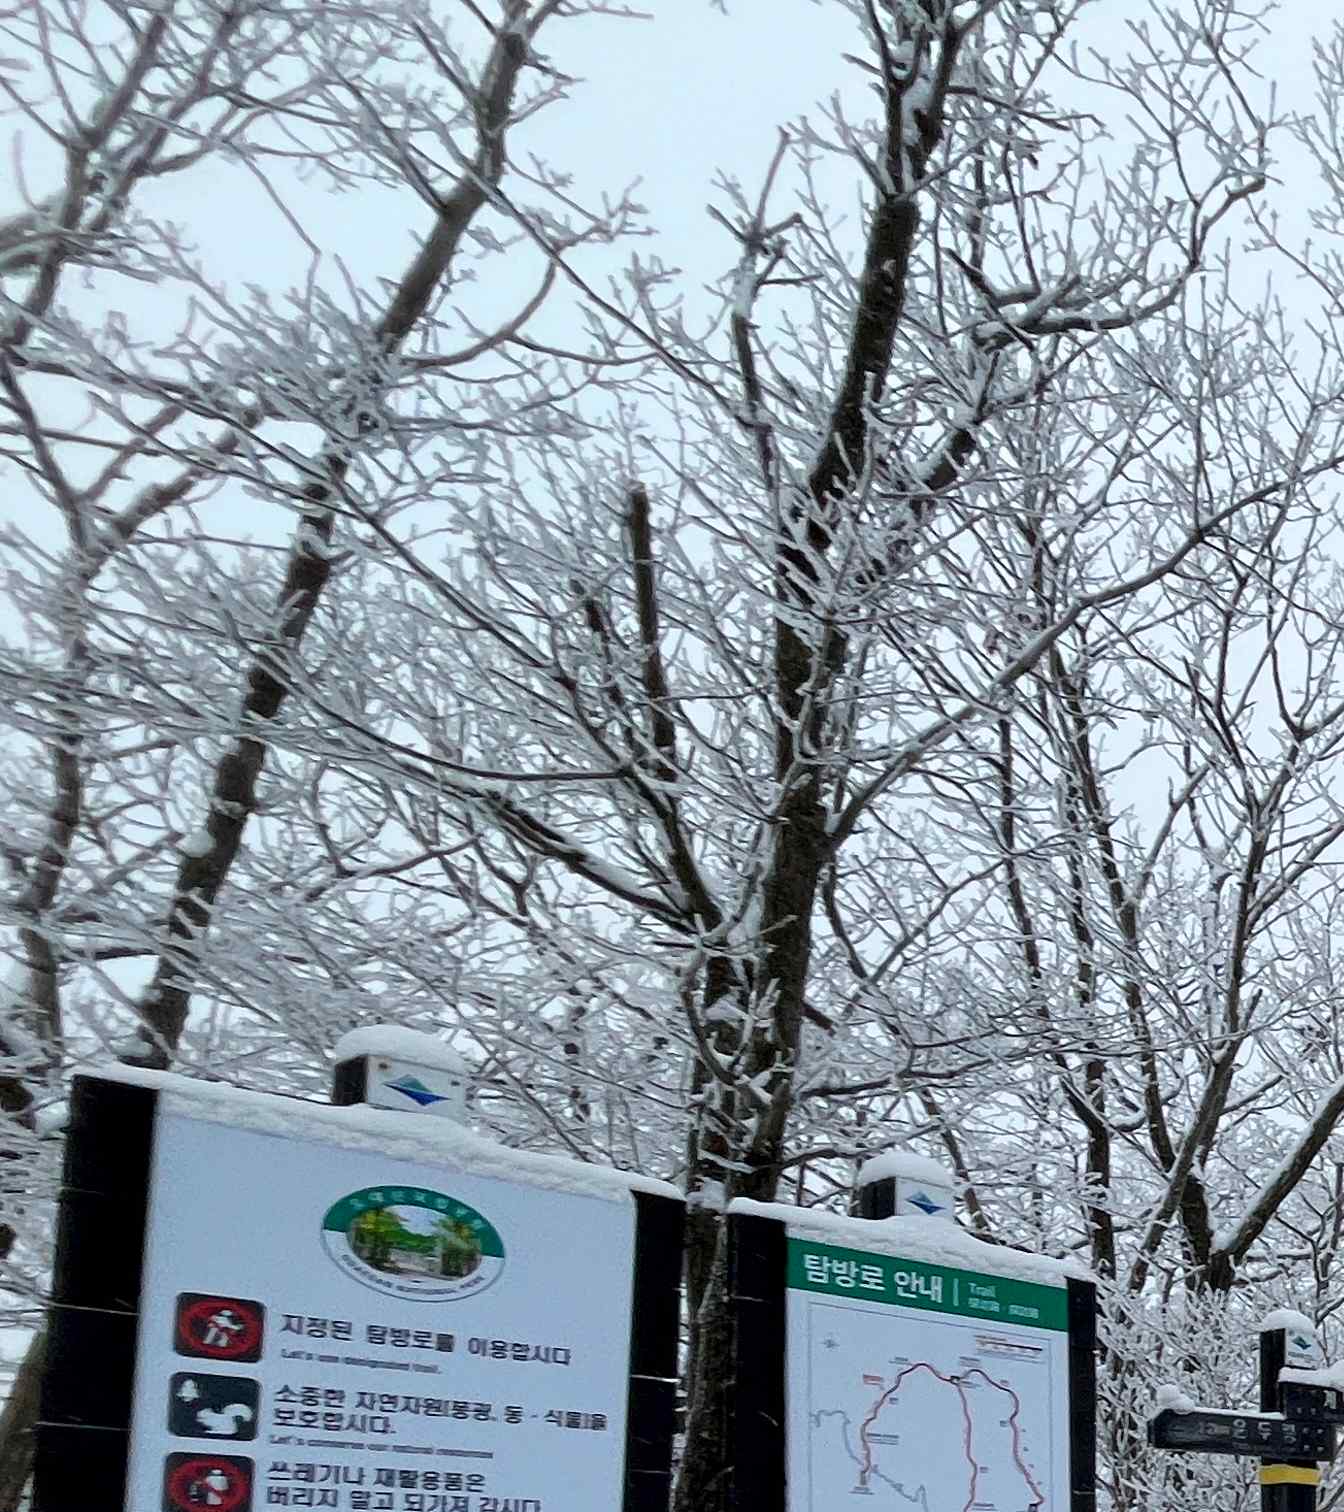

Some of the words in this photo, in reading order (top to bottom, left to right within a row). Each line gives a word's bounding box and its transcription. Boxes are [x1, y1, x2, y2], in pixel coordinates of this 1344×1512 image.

[803, 1253, 885, 1291] 탐방로
[894, 1271, 944, 1303] 안내
[968, 1282, 996, 1297] Trail
[280, 1314, 352, 1341] 지정된
[366, 1324, 454, 1352] 탐방로를
[468, 1337, 571, 1365] 이용합시다
[274, 1385, 345, 1408] 소중한
[505, 1405, 524, 1424] 동
[272, 1408, 396, 1433] 보호합시다.
[1231, 1417, 1297, 1447] 운두령
[268, 1461, 366, 1485] 쓰레기나
[373, 1468, 485, 1492] 재활용품은
[266, 1486, 338, 1507] 버리지
[351, 1490, 394, 1510] 말고
